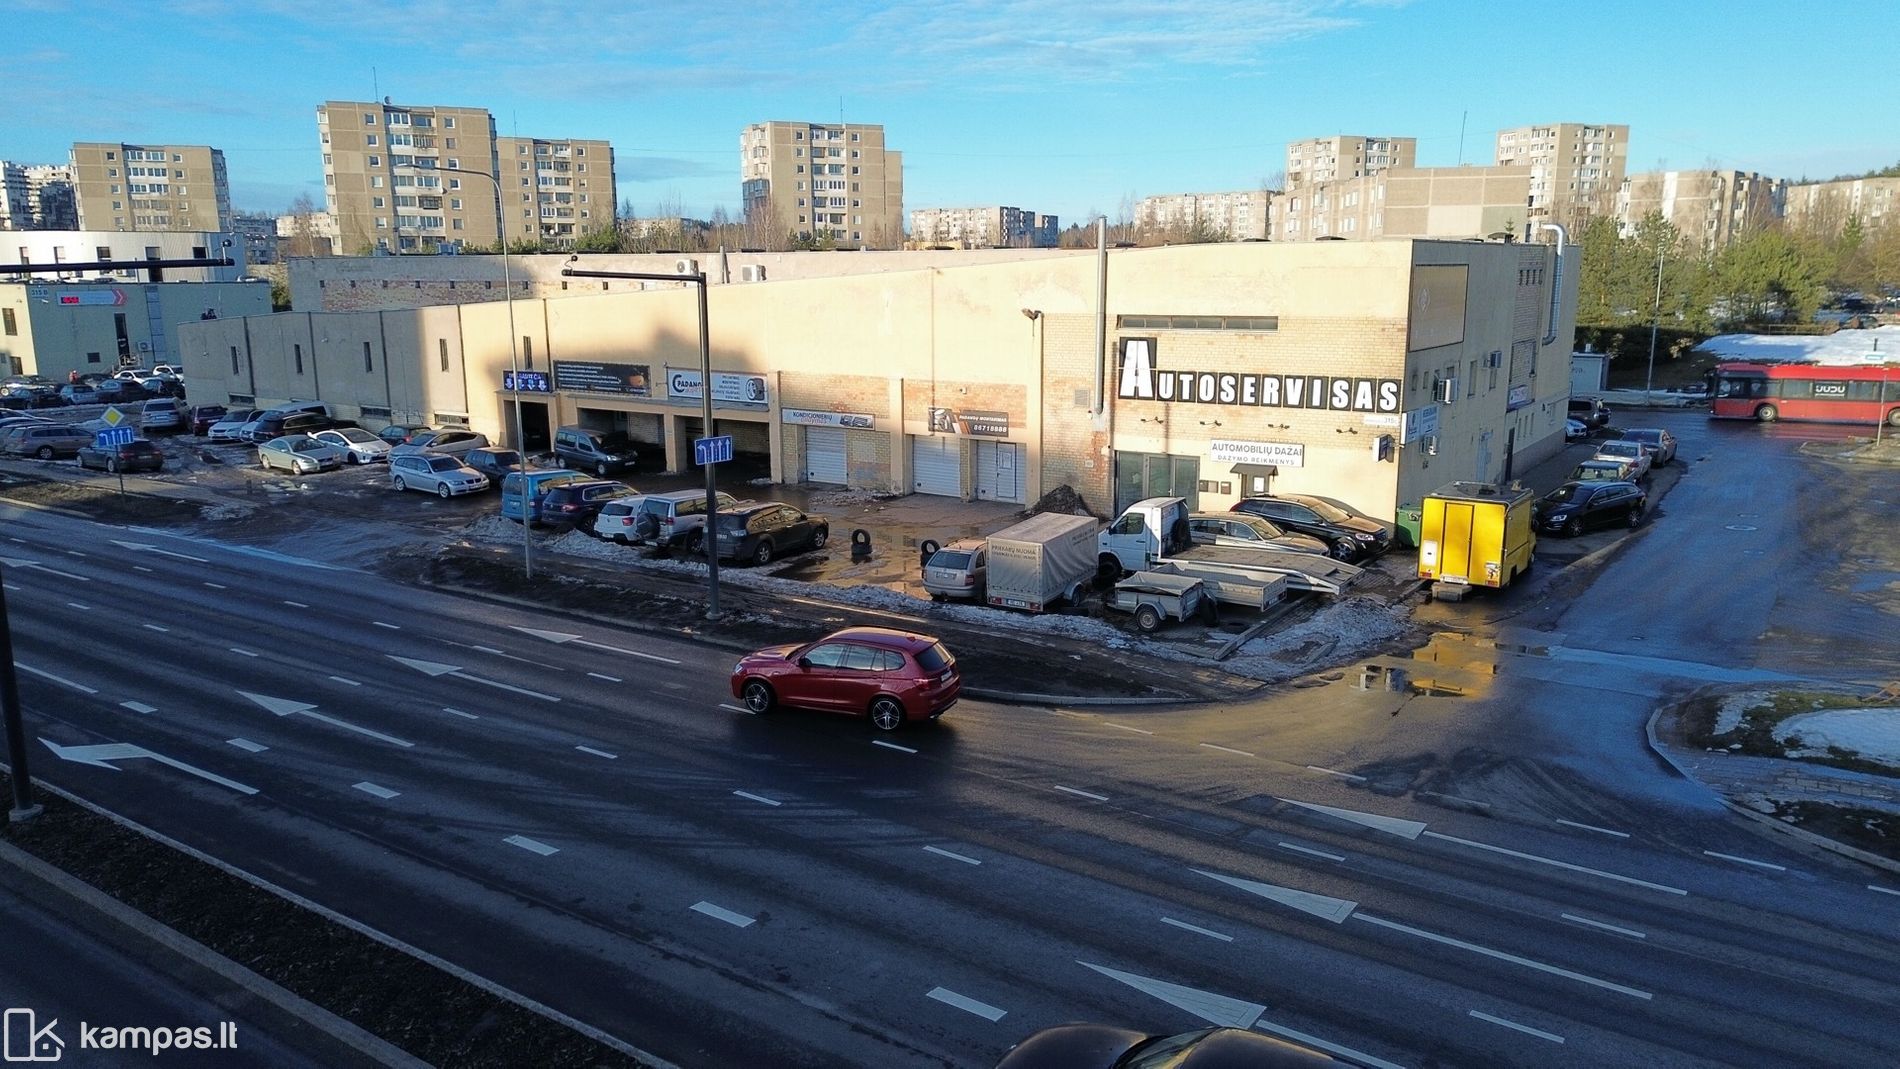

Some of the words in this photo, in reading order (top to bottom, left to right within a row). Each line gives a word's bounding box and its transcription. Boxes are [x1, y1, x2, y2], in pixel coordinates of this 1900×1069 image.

[1120, 340, 1398, 411] AUTOSERVISAS
[1815, 385, 1845, 393] JUDU
[1212, 443, 1272, 456] AUTOMOBILIŲ
